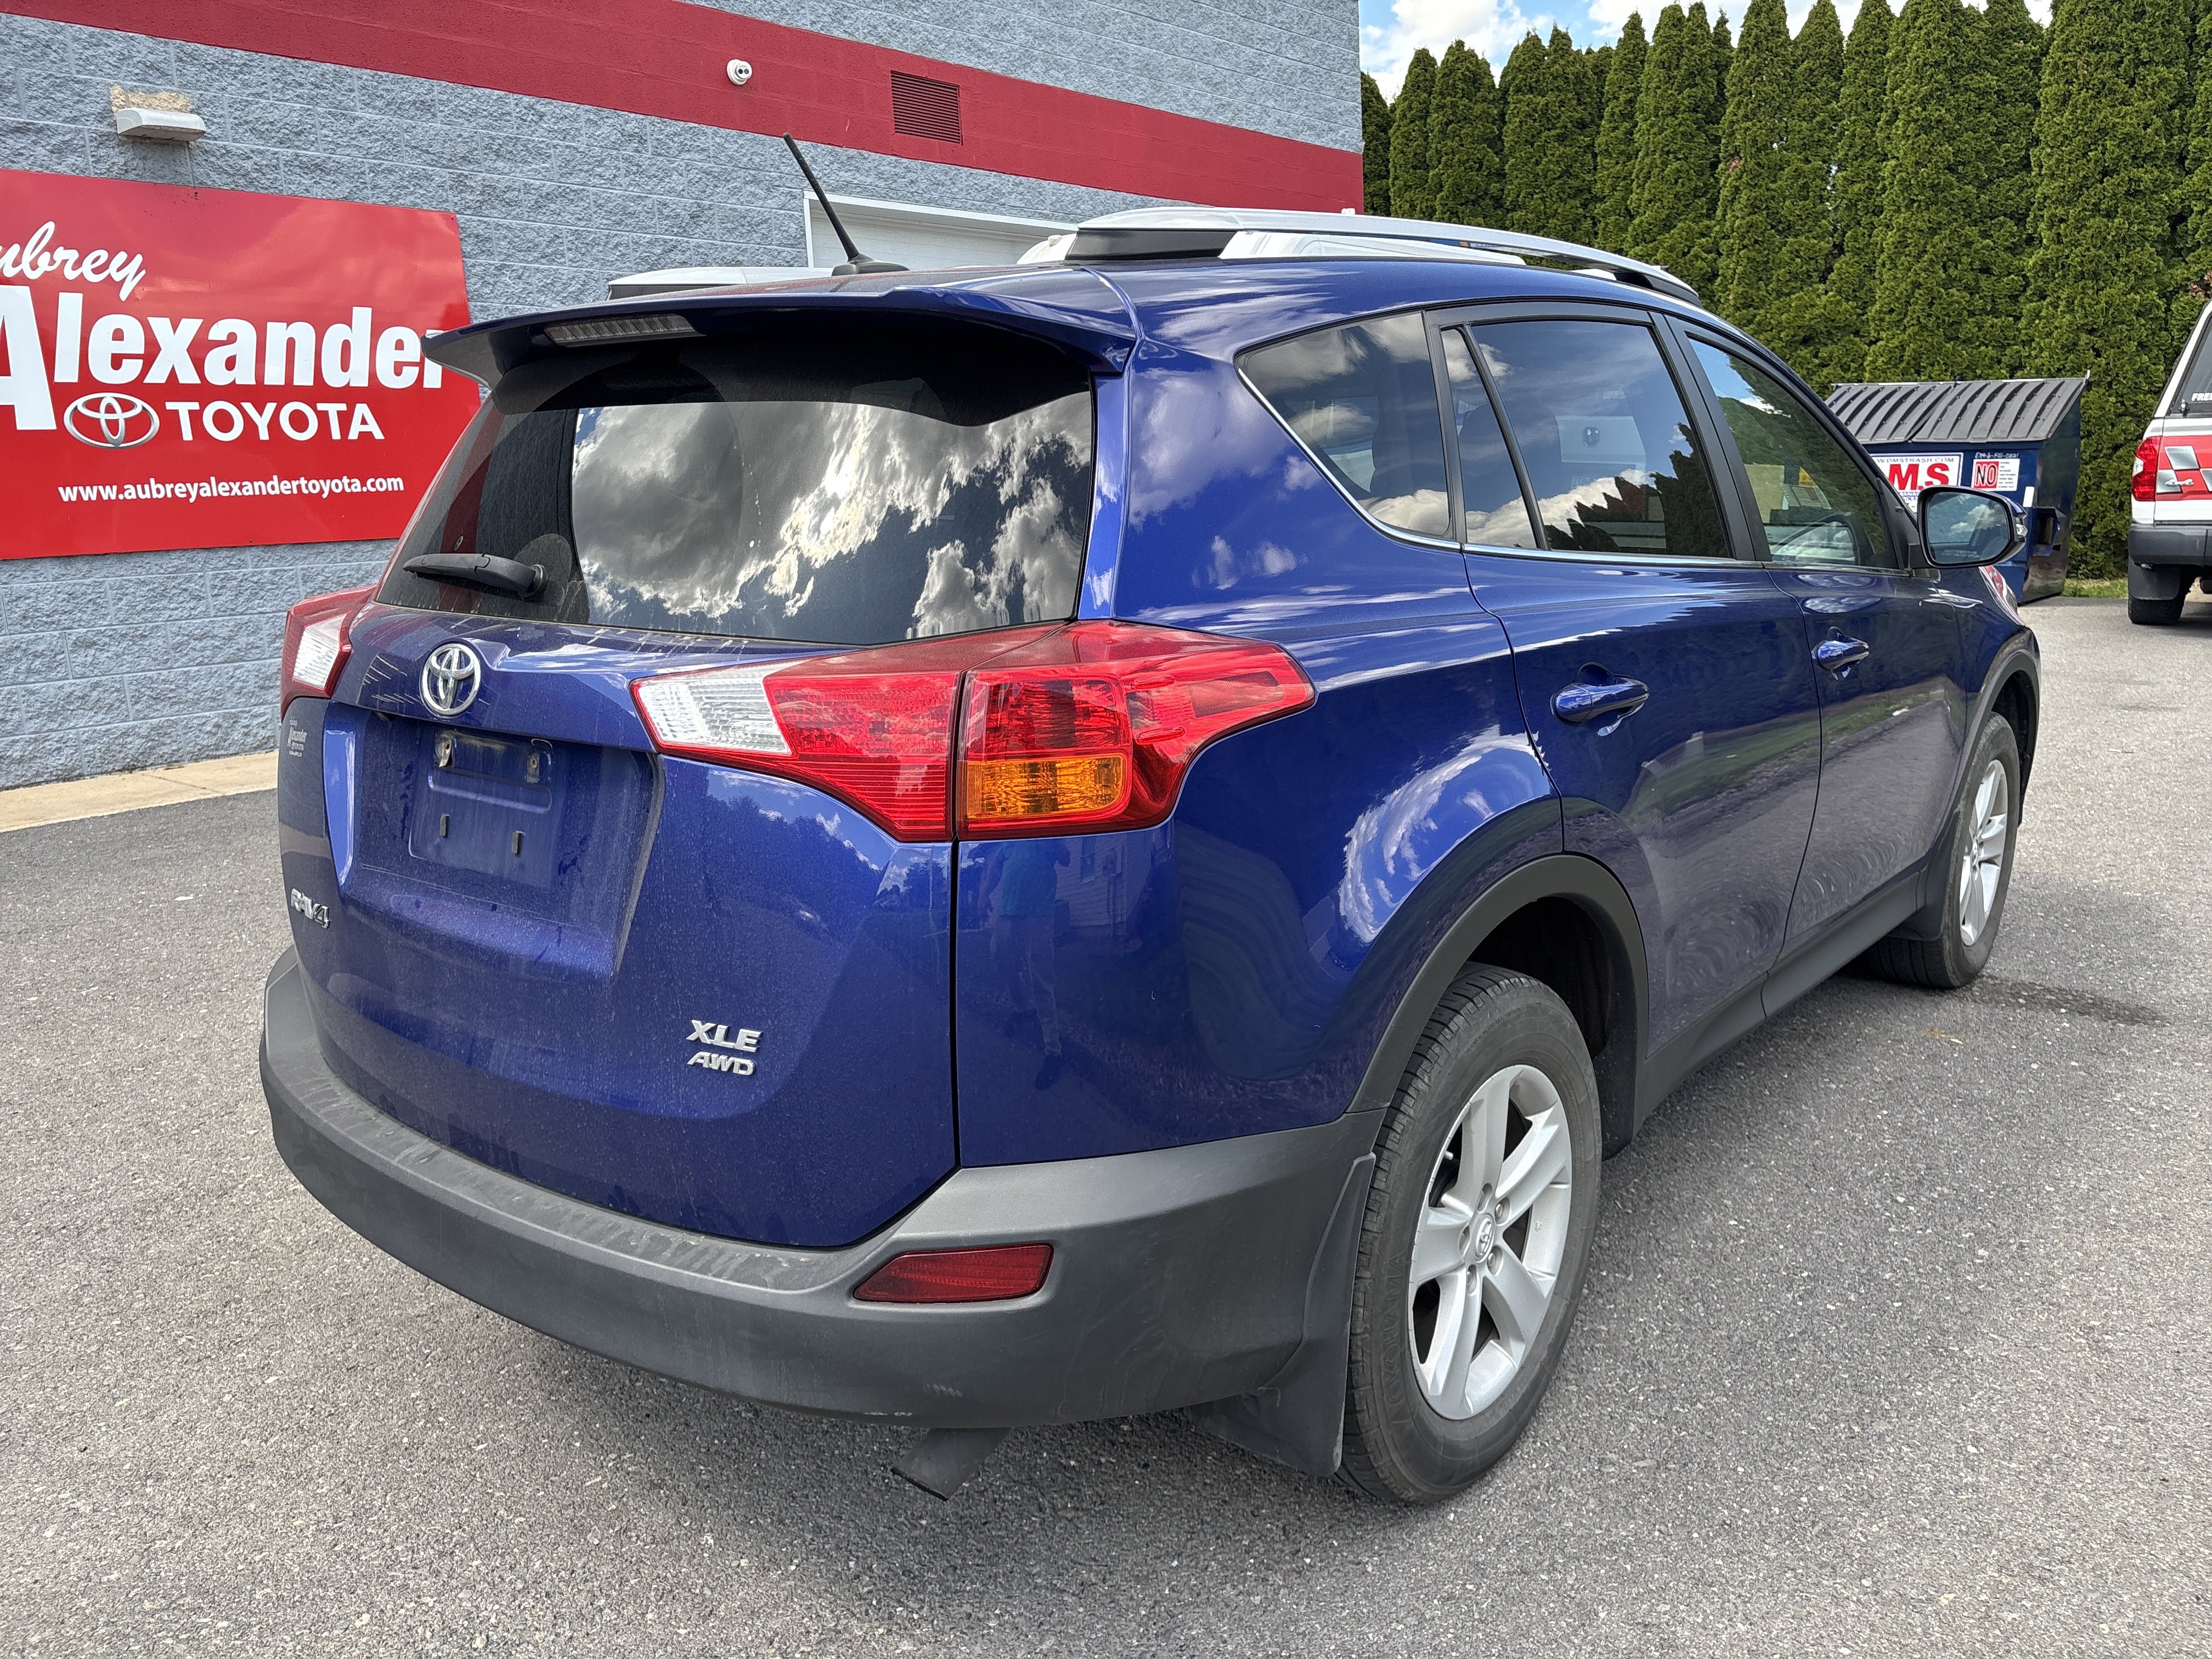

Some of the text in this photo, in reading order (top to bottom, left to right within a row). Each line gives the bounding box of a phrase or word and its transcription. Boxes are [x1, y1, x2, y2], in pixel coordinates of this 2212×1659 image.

[0, 221, 146, 302] ubrey
[2191, 393, 2212, 402] FRE
[165, 400, 385, 441] TOYOTA
[58, 475, 404, 504] www.aubreyalexandertoyota.com
[1976, 464, 1997, 486] NO
[291, 888, 331, 929] RAV4
[685, 1019, 764, 1052] XLE
[687, 1051, 757, 1076] AWD
